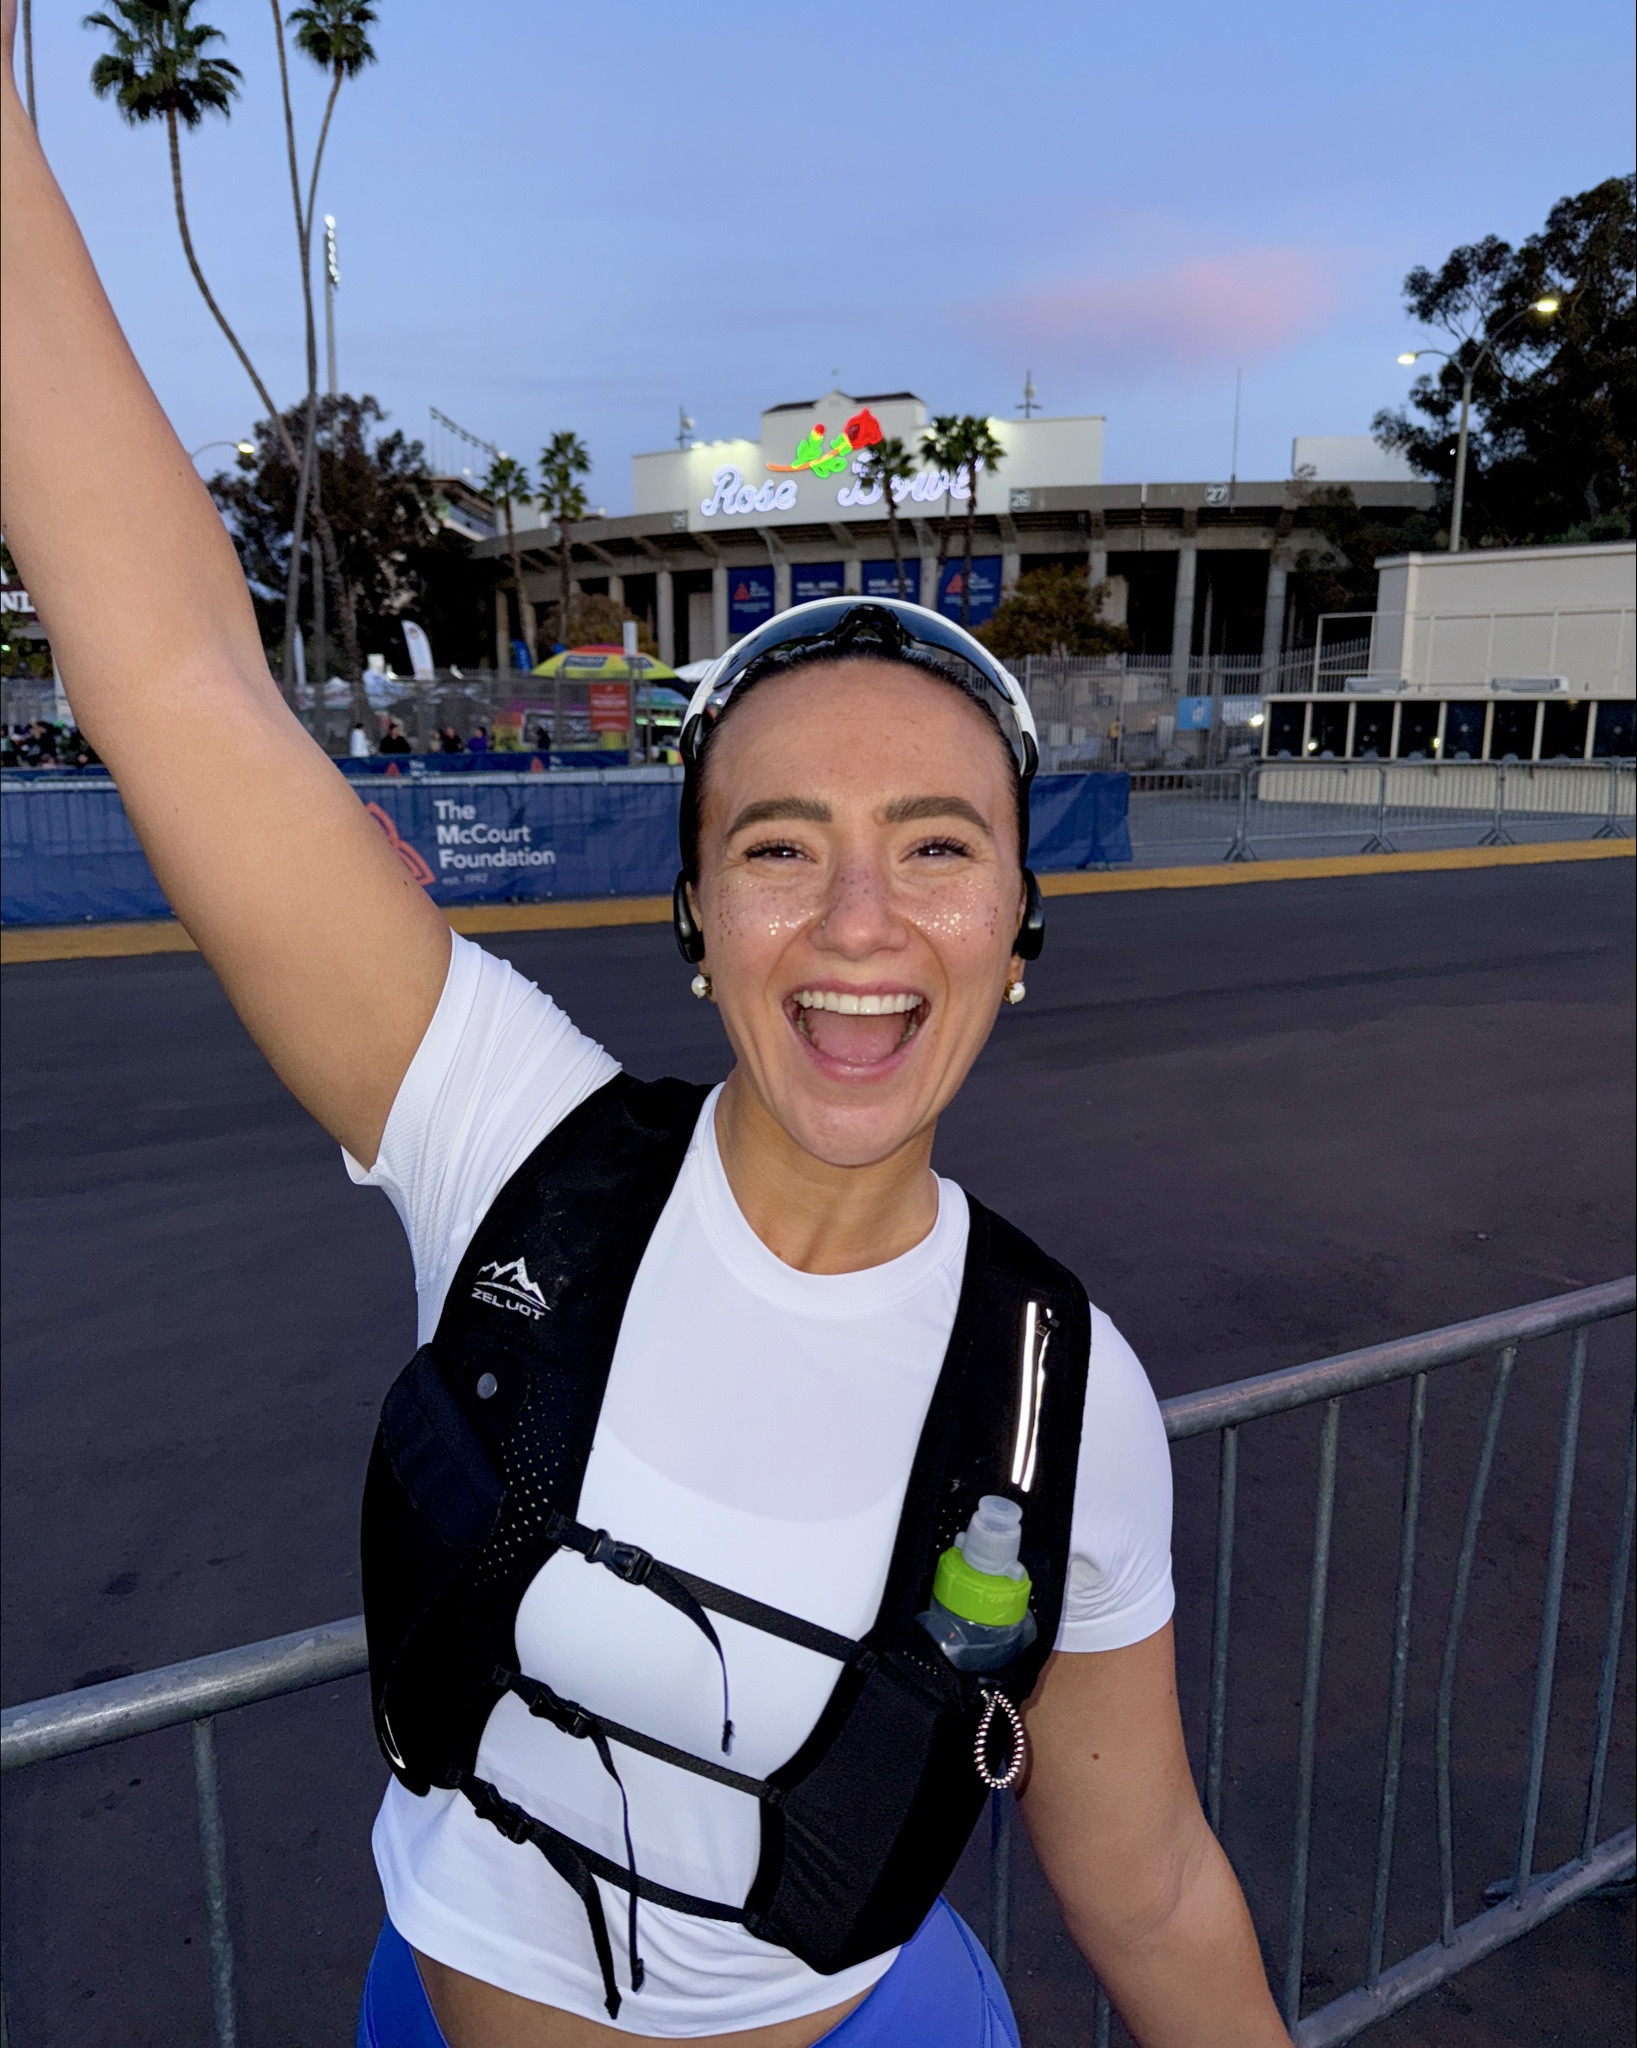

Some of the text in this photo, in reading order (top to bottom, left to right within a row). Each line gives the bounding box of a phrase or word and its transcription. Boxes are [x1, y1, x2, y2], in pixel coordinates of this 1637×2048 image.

[701, 464, 798, 517] Rose
[1206, 486, 1226, 502] 27
[433, 799, 476, 820] The
[436, 823, 532, 845] McCourt
[438, 847, 556, 869] Foundation
